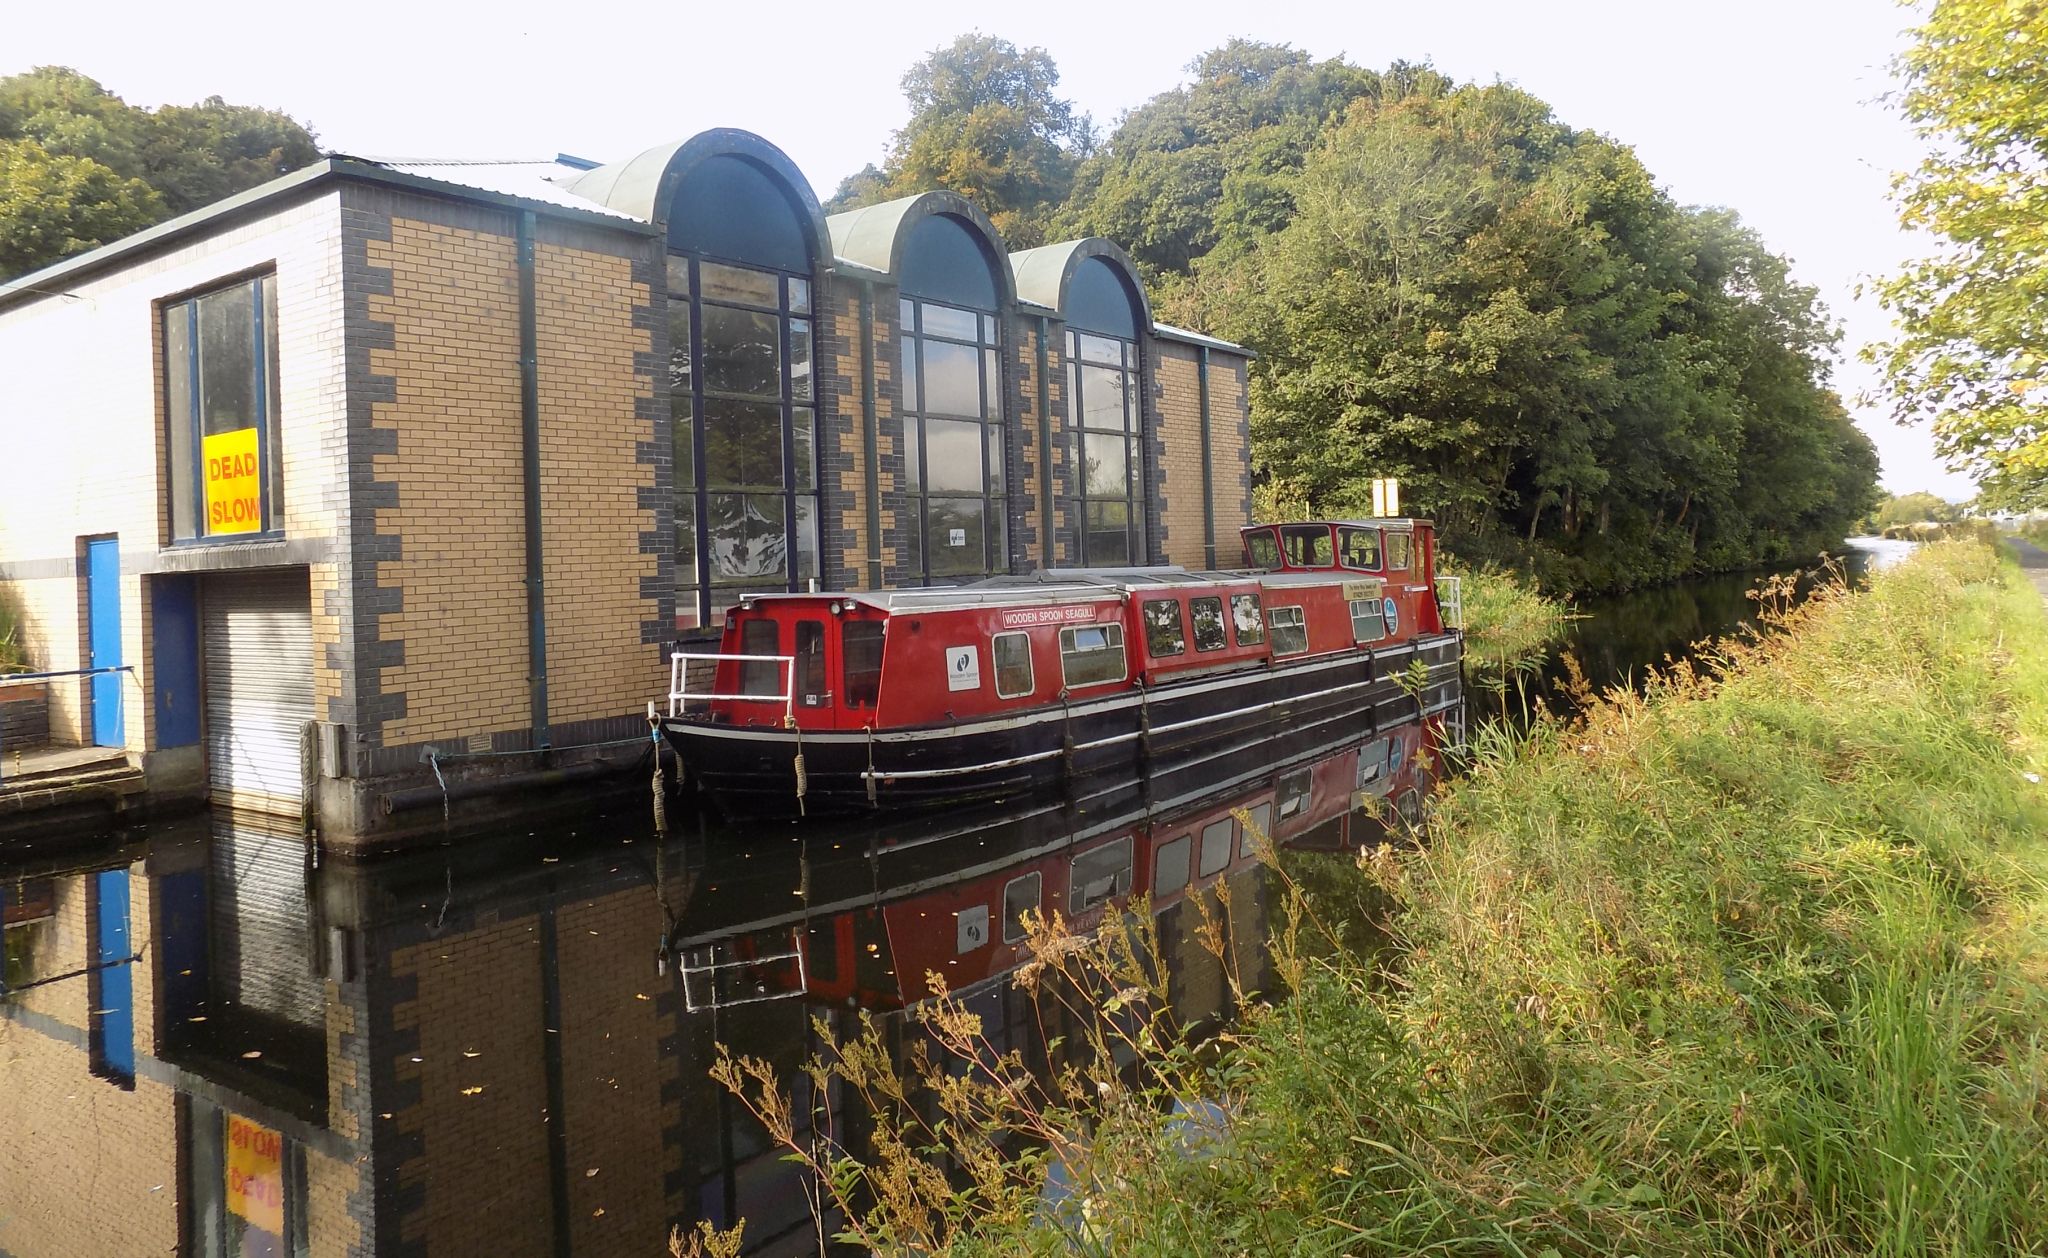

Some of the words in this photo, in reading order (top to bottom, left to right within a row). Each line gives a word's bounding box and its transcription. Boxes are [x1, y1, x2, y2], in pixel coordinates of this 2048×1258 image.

[209, 453, 257, 481] DEAD
[212, 497, 260, 525] SLOW
[1005, 612, 1038, 624] WOODEN
[1039, 609, 1063, 622] SPOON
[1065, 607, 1094, 619] SEAGULL
